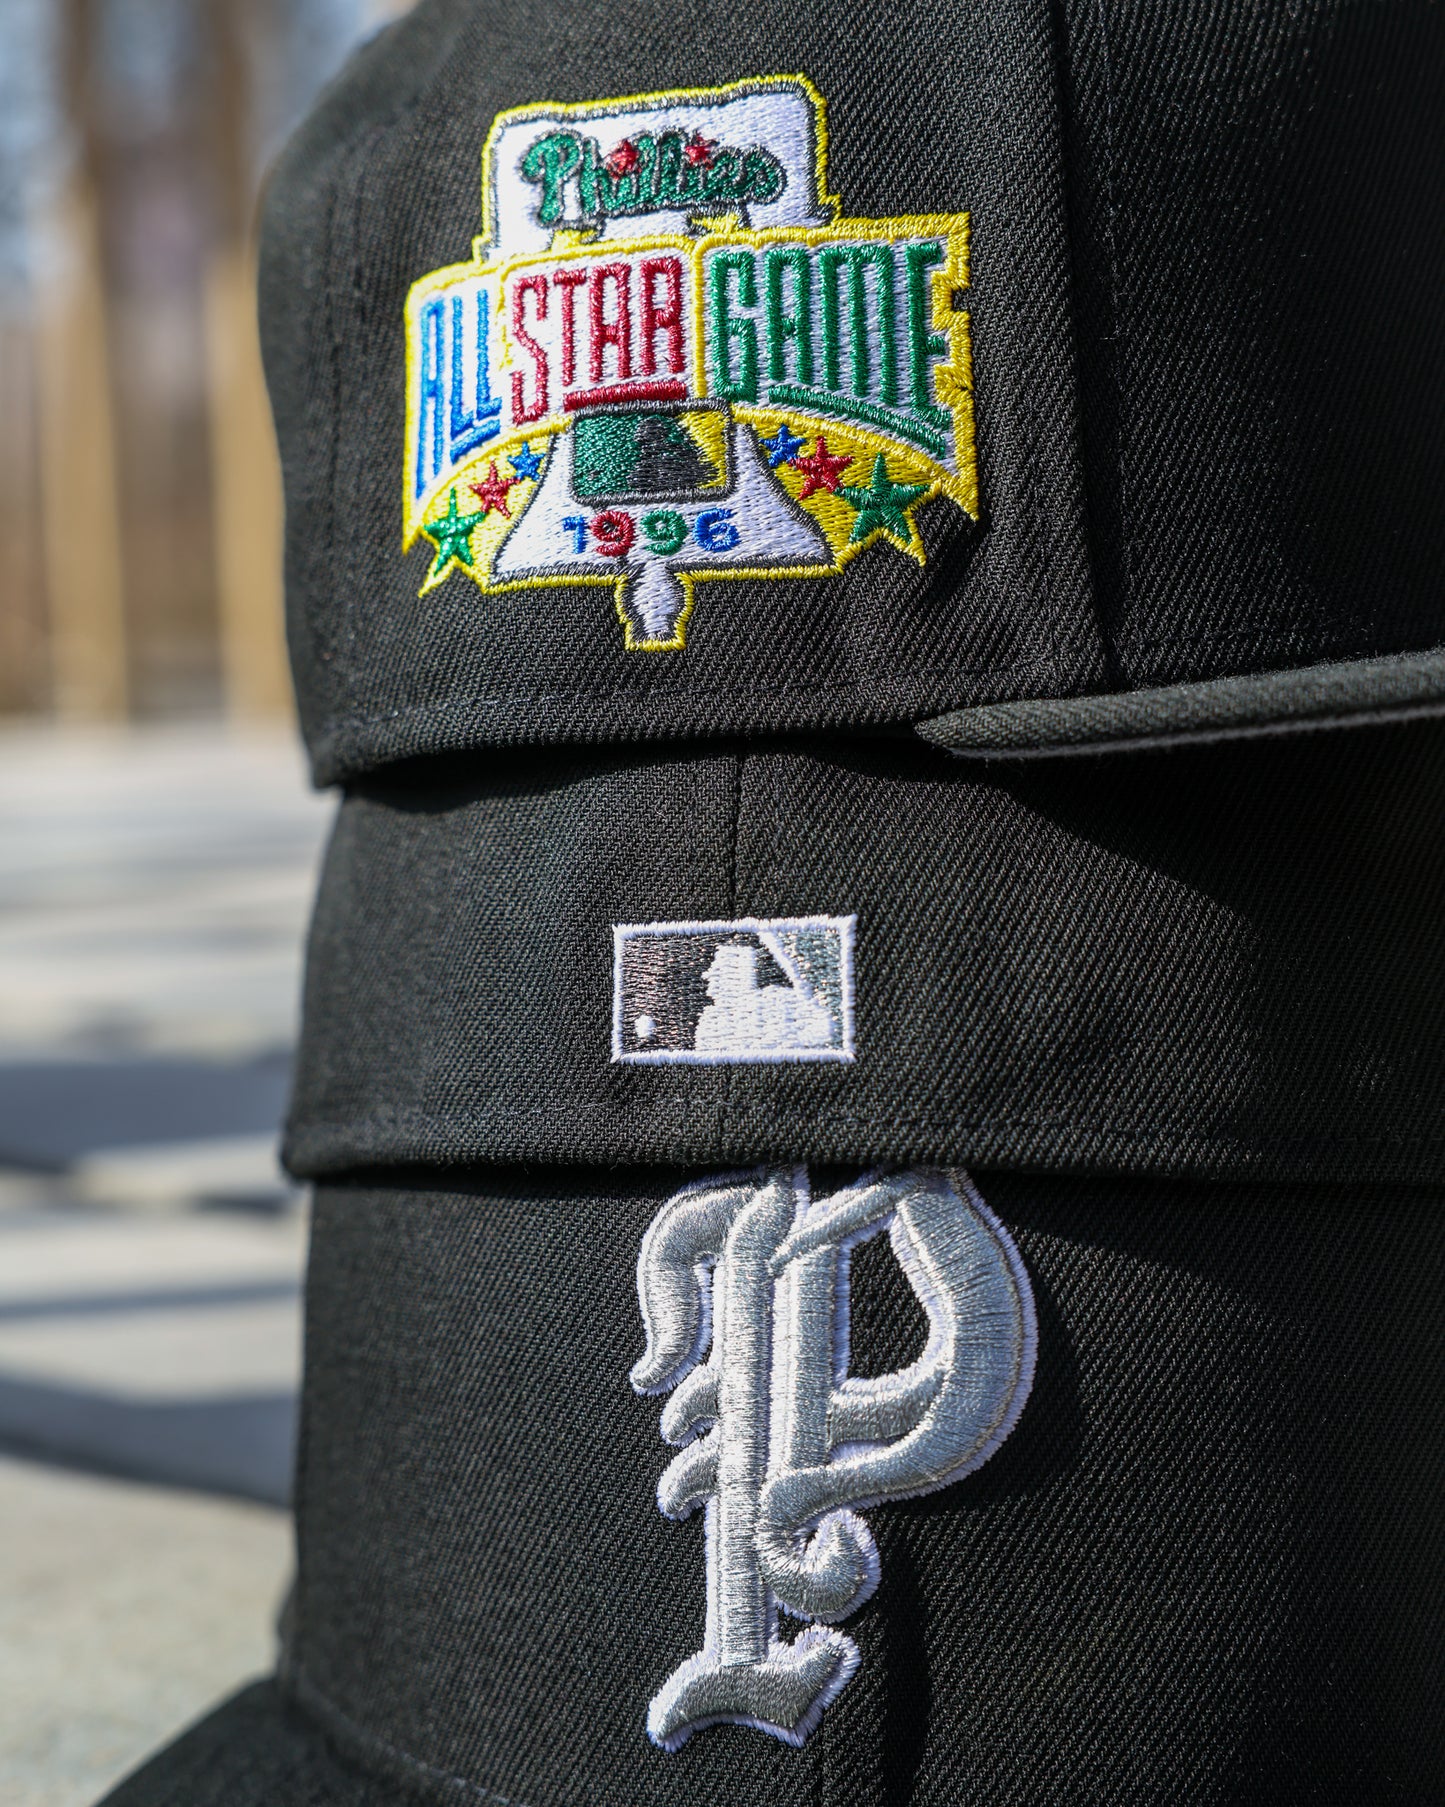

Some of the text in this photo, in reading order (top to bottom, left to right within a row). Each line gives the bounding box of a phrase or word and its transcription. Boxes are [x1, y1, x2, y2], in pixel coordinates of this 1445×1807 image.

[519, 125, 788, 228] Phillies
[415, 241, 952, 499] ALL STAR GAME
[562, 508, 741, 557] 1996
[630, 1166, 1039, 1753] P
